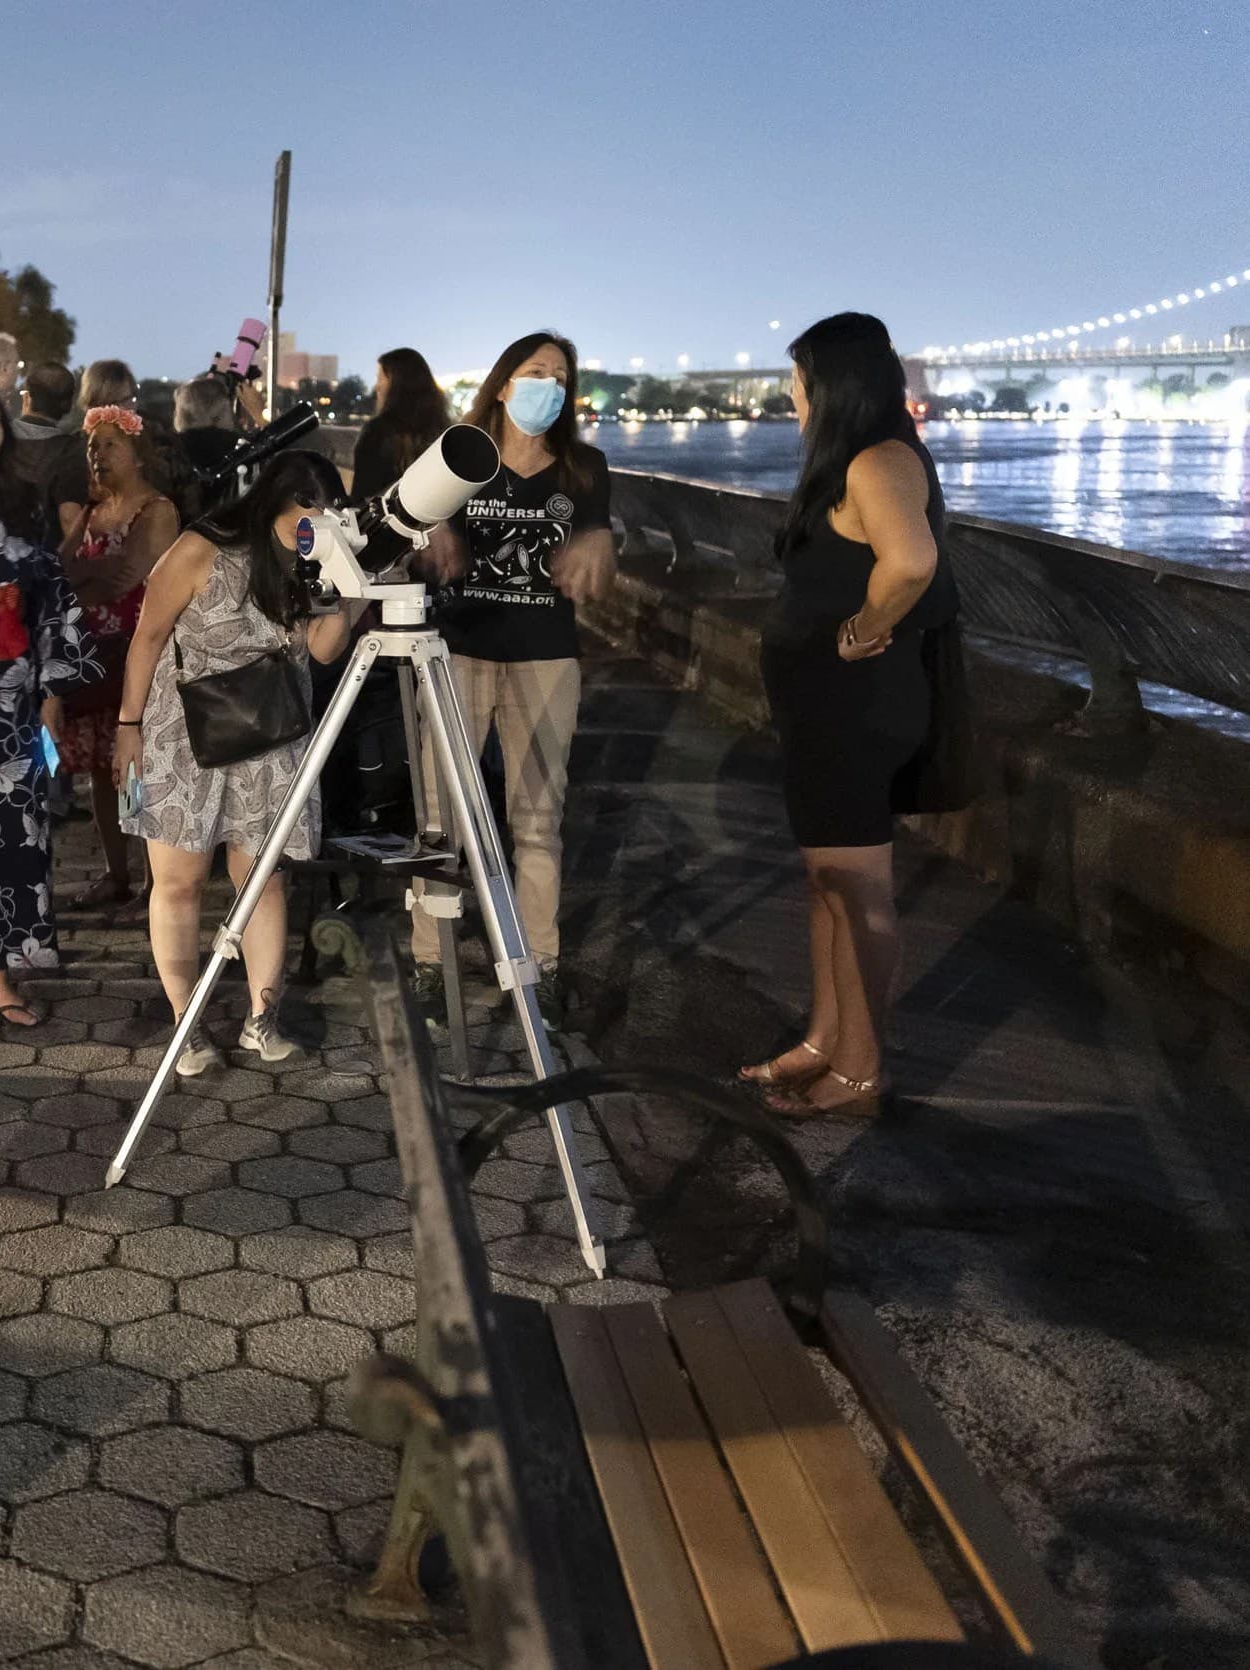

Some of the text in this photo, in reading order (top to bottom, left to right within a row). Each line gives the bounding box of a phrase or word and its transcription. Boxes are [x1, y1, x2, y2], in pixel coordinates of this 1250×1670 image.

[467, 498, 507, 508] see the
[466, 506, 546, 518] UNIVERSE
